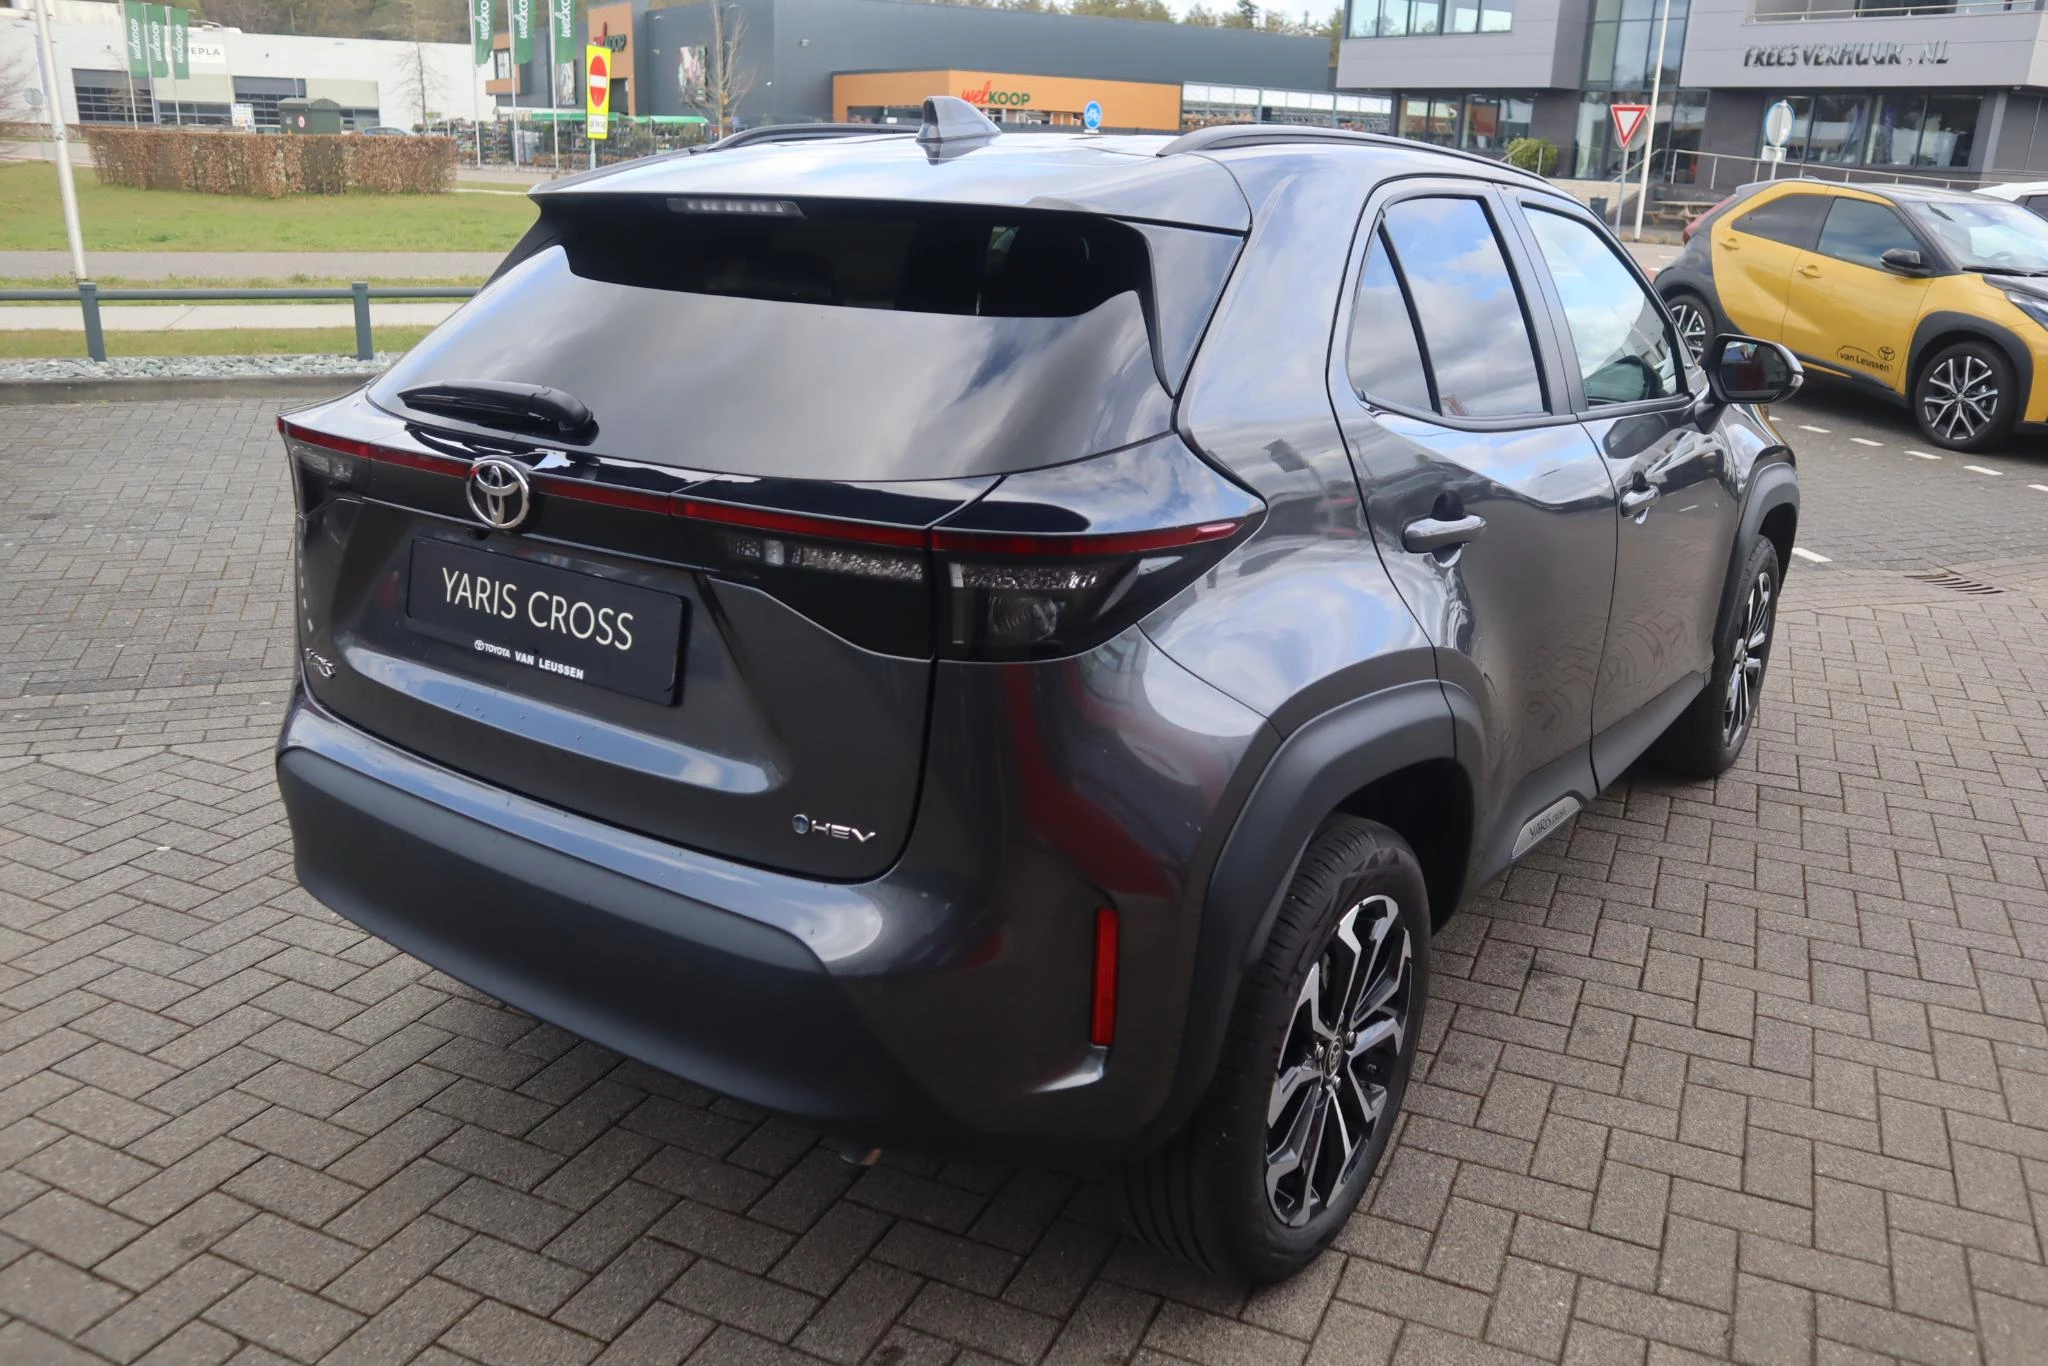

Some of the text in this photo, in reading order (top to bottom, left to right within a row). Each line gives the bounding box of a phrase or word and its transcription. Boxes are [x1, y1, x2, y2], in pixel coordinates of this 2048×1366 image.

[1840, 352, 1889, 372] van Leussen
[442, 567, 634, 650] YARIS CROSS
[484, 643, 584, 680] TOYOTA VAN LEUSSEN
[811, 820, 876, 842] HEV
